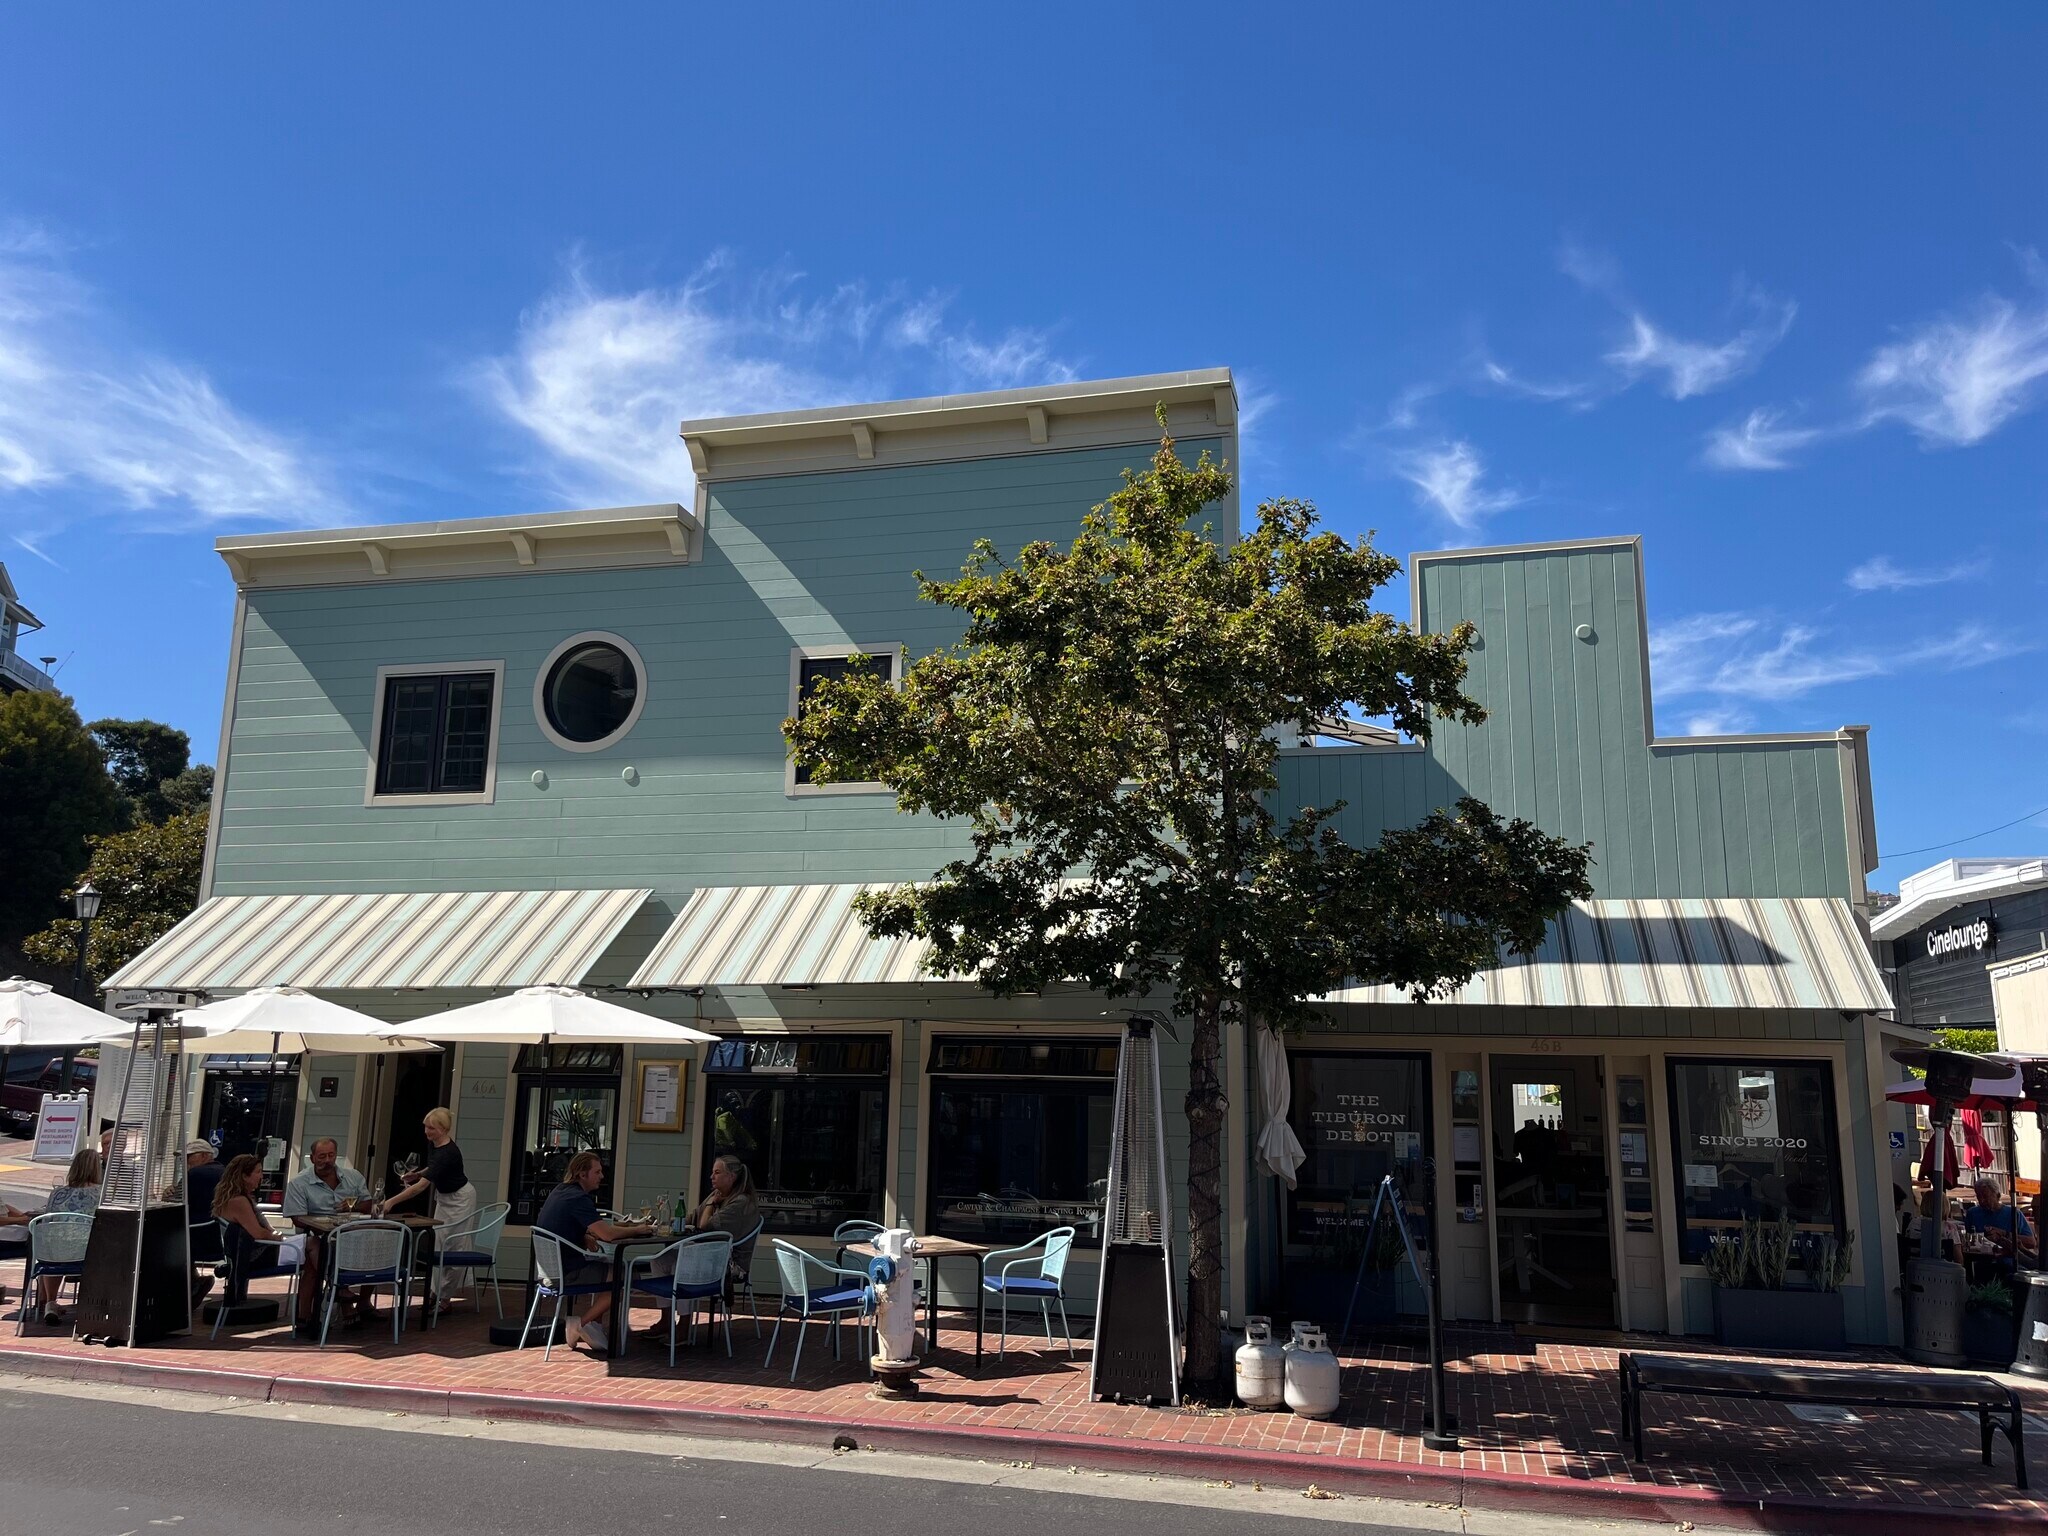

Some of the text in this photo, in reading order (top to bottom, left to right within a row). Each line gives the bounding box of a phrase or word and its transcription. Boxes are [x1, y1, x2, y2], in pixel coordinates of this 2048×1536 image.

[1927, 917, 1988, 956] Cinelounge
[472, 1080, 496, 1094] 46A
[1337, 1094, 1379, 1106] THE
[1312, 1111, 1407, 1125] TIBURON
[1699, 1135, 1807, 1149] SINCE 2020
[957, 1202, 982, 1211] CAVIAR
[985, 1203, 992, 1211] &
[995, 1203, 1040, 1213] CHAMPAGNE
[1043, 1205, 1073, 1215] TASTING
